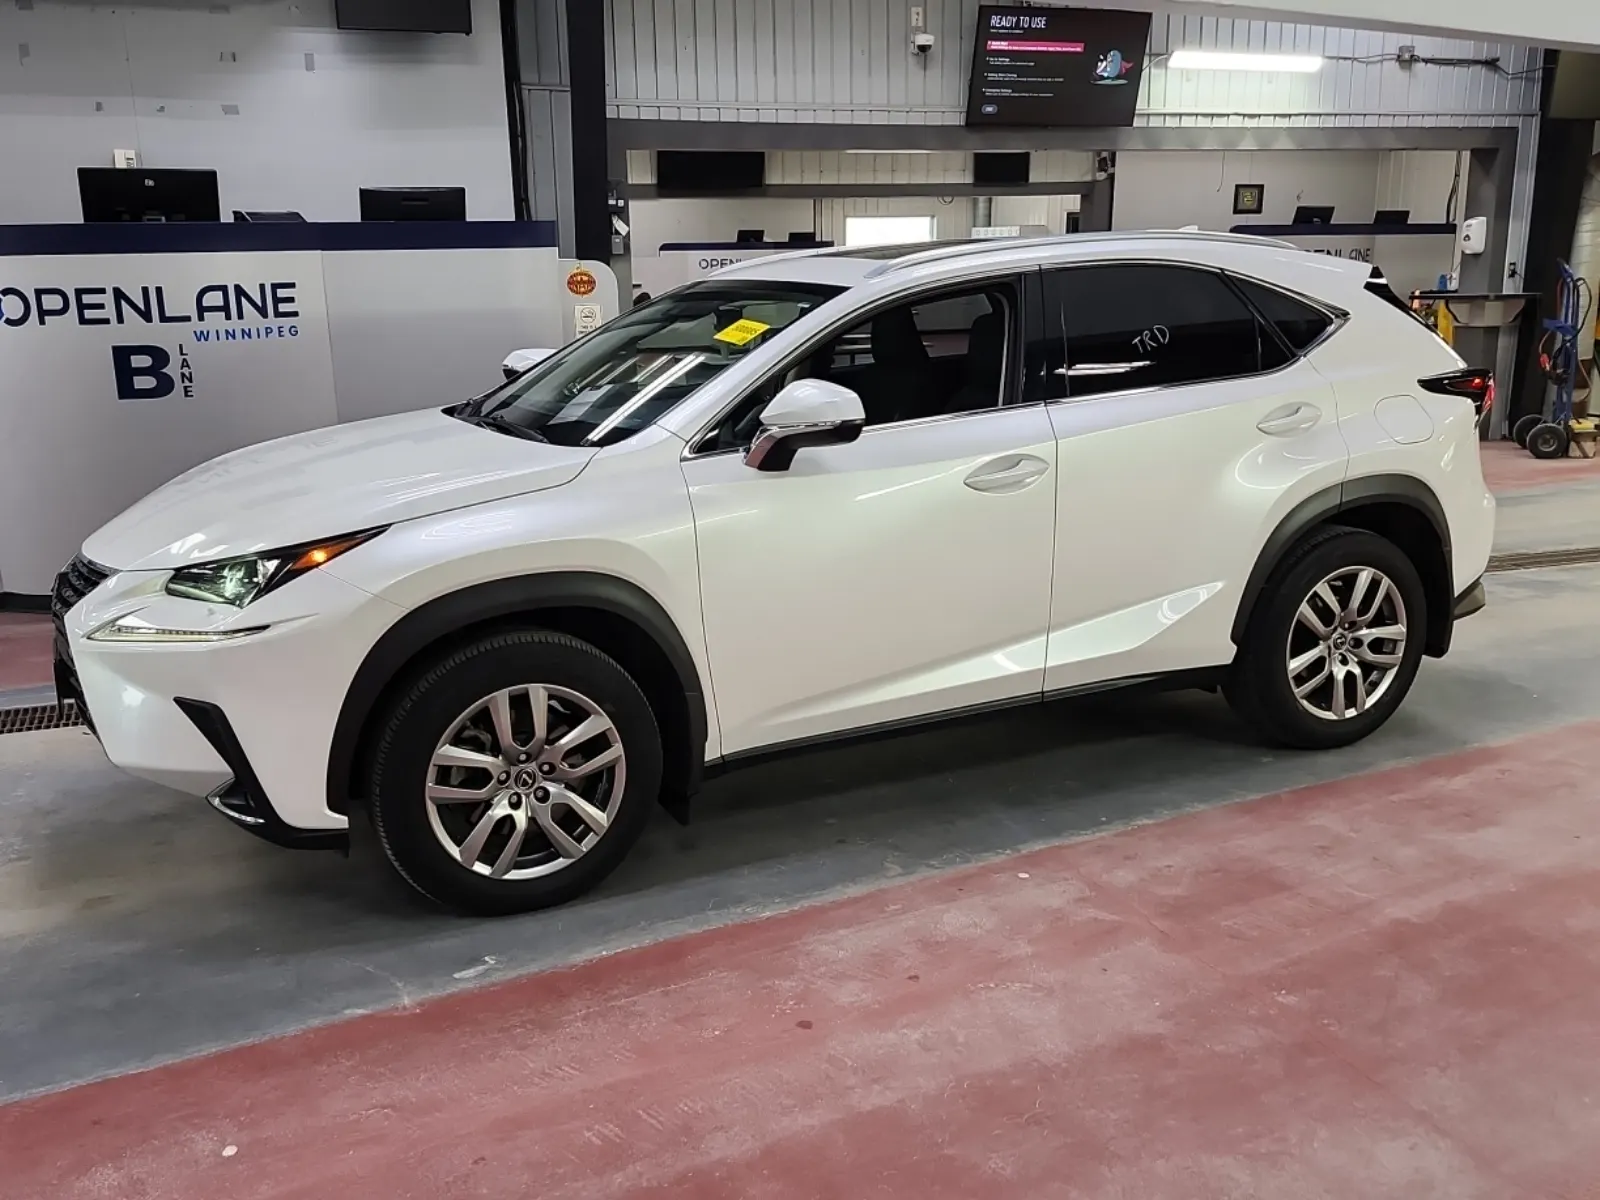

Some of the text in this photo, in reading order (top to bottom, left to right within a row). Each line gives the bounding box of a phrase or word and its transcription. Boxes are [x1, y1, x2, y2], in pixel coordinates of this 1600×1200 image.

[991, 15, 1046, 28] READY TO USE
[698, 258, 742, 270] OPEN
[0, 282, 299, 327] OPENLANE
[193, 325, 299, 342] WINNIPEG
[1131, 324, 1169, 354] TRD
[111, 343, 194, 400] B LANE
